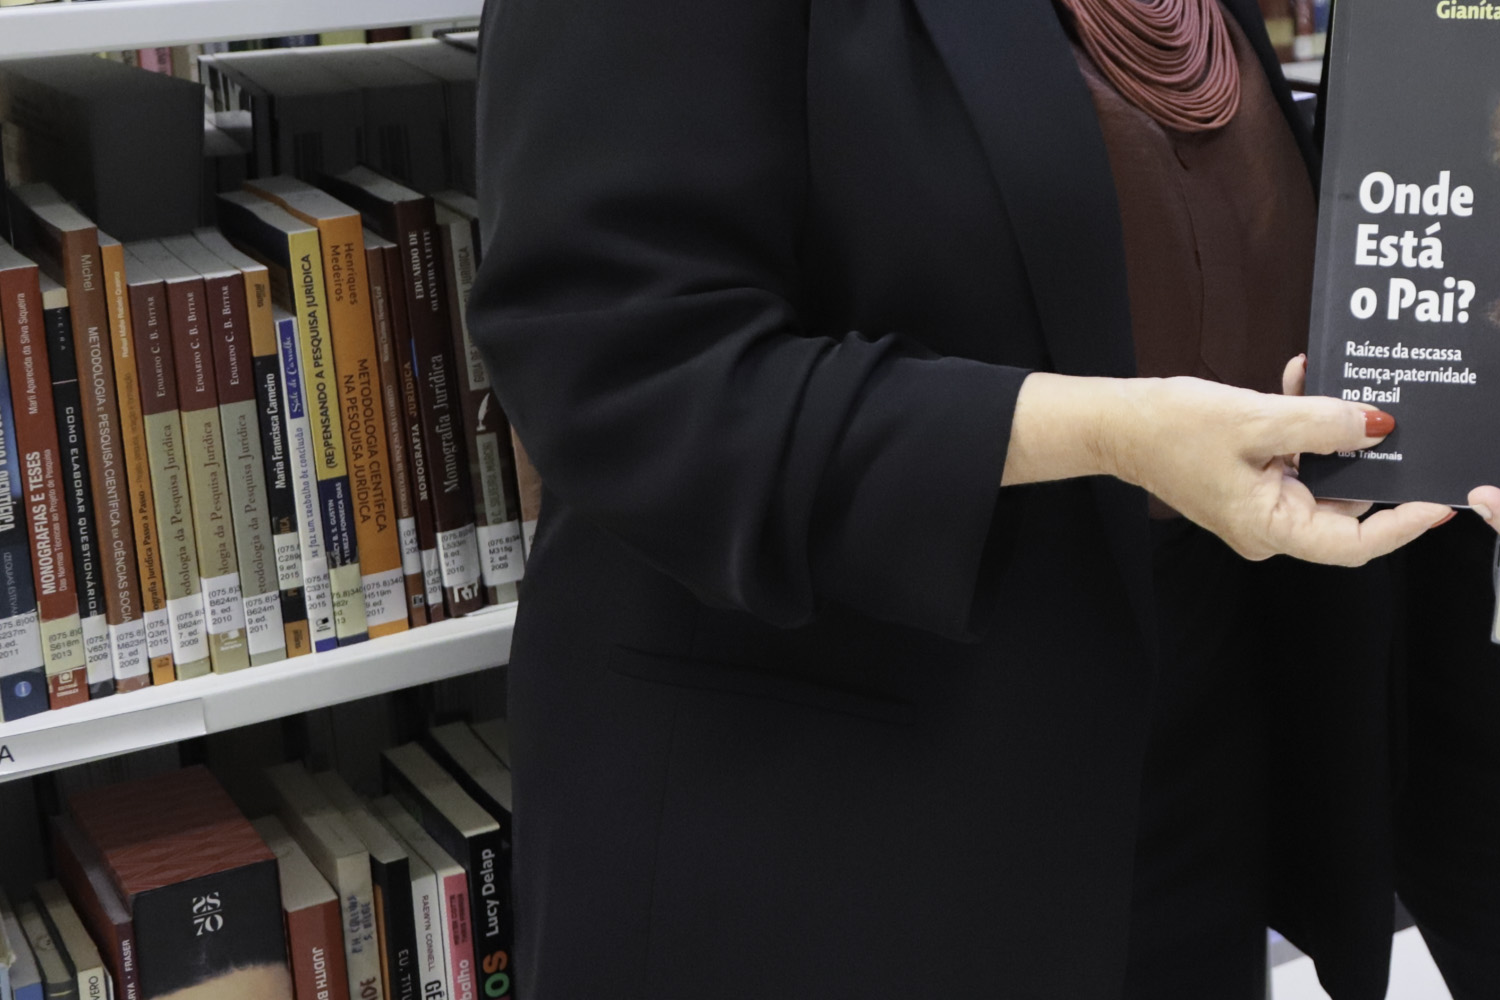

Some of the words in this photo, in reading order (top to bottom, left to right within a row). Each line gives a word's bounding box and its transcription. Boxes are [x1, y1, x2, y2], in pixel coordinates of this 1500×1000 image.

[1359, 171, 1473, 216] Onde
[1355, 222, 1444, 269] Está
[79, 253, 95, 291] Michel
[298, 254, 317, 308] JURÍDICA
[328, 244, 347, 301] Medeiros
[341, 242, 360, 305] Henriques
[15, 292, 28, 324] Siqueira
[1350, 287, 1377, 319] o
[1387, 277, 1475, 323] Pai?
[18, 325, 29, 344] Silva
[21, 345, 30, 355] da
[306, 309, 324, 367] PESQUISA
[1346, 341, 1389, 358] Raízes
[1391, 342, 1408, 359] da
[1410, 348, 1462, 361] escassa
[22, 356, 37, 394] Aparecida
[263, 372, 279, 414] Carneiro
[314, 370, 325, 379] A
[343, 374, 355, 394] NA
[401, 360, 418, 417] JURÍDICA
[425, 353, 449, 410] Jurídica
[1344, 363, 1476, 385] licença-paternidade
[26, 394, 37, 414] Marli
[1342, 389, 1360, 402] no
[1361, 386, 1400, 404] Brasil
[267, 414, 283, 459] Francisca
[316, 381, 337, 468] (RE)PENSANDO
[343, 396, 364, 460] PESQUISA
[197, 421, 219, 468] Jurídica
[356, 358, 379, 459] METODOLOGIA
[368, 459, 390, 532] CIENTÍFICA
[410, 423, 429, 500] MONOGRAFIA
[434, 413, 461, 493] Monografia
[1358, 449, 1402, 461] Tribunais
[25, 451, 44, 491] TESES
[272, 460, 287, 488] Maria
[30, 493, 45, 501] E
[204, 470, 226, 520] Pesquisa
[353, 462, 372, 523] JURÍDICA
[31, 503, 56, 594] MONOGRAFIAS
[214, 524, 225, 538] da
[280, 571, 300, 580] 2015
[212, 615, 232, 625] 2010
[249, 624, 269, 634] 2011
[51, 650, 73, 661] 2013
[478, 848, 497, 895] Delap
[421, 894, 431, 931] RAEWYN
[483, 899, 501, 937] Lucy
[121, 938, 133, 971] FRASER
[311, 946, 328, 989] JUDITH
[424, 933, 435, 972] CONNELL
